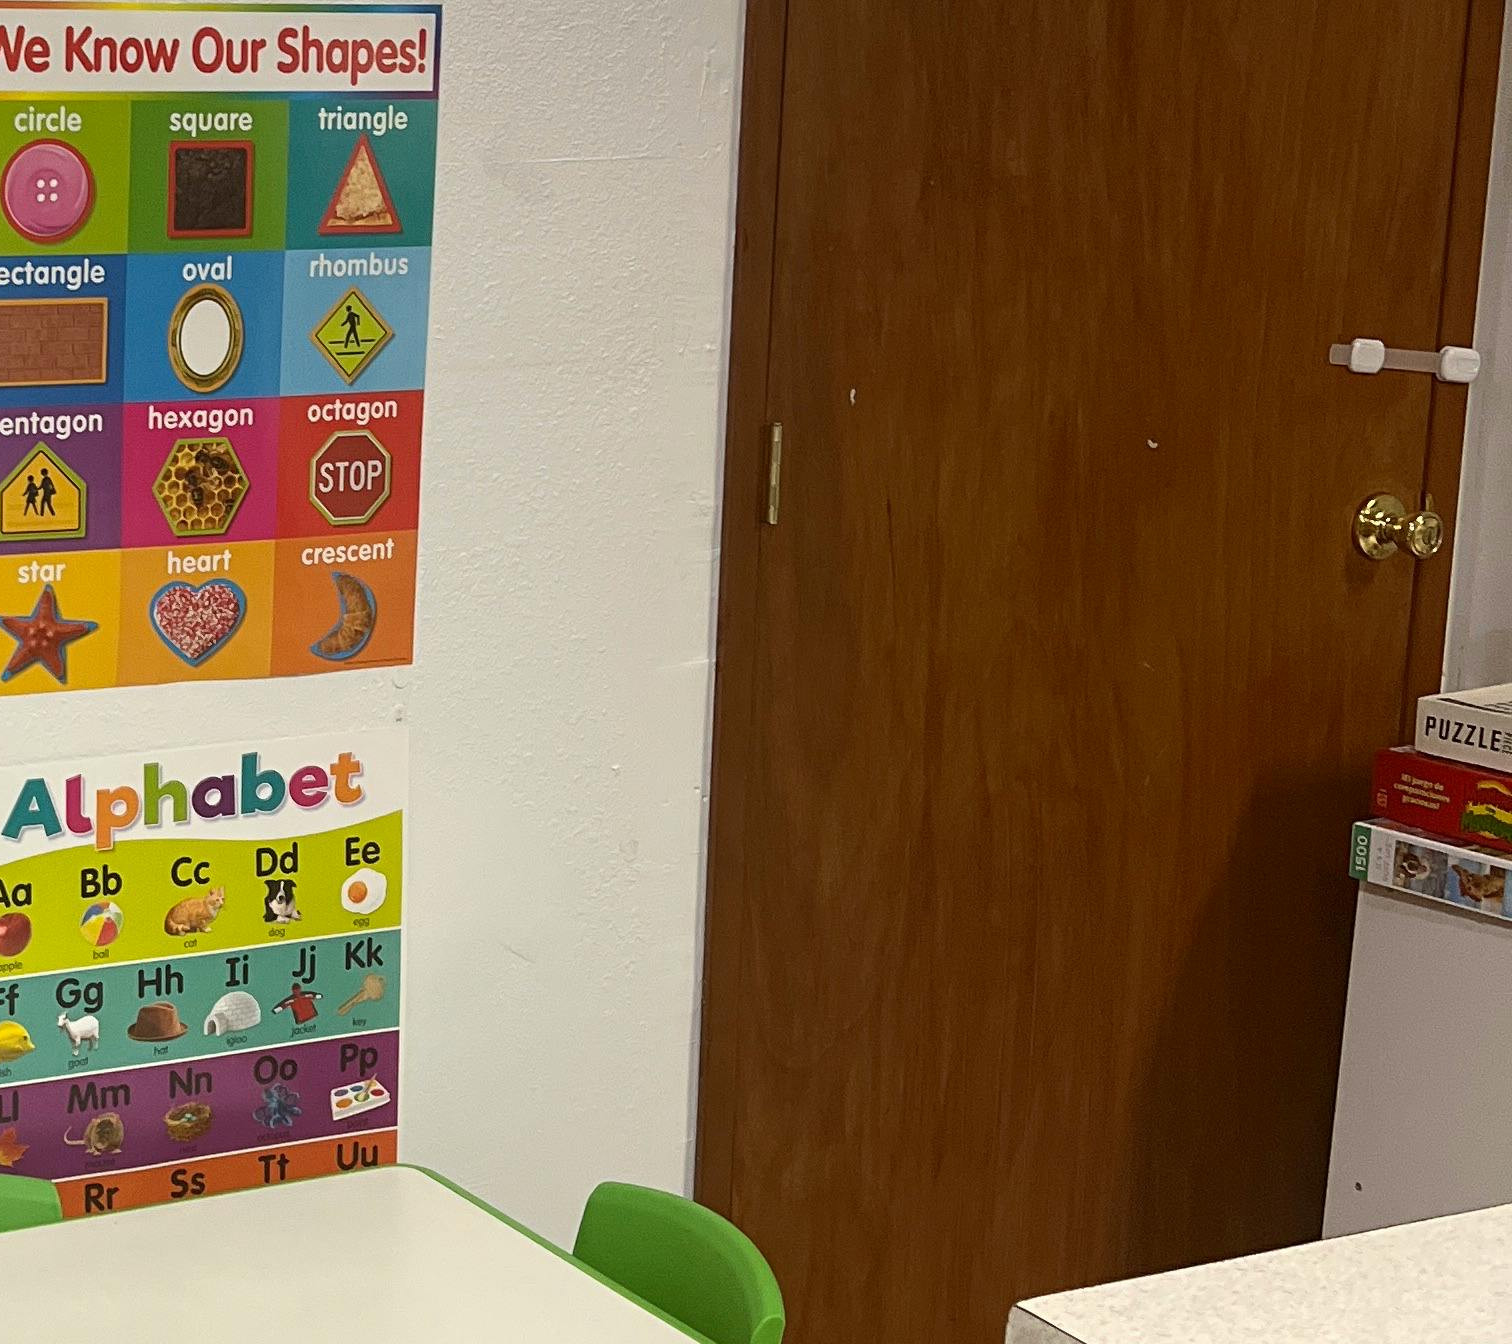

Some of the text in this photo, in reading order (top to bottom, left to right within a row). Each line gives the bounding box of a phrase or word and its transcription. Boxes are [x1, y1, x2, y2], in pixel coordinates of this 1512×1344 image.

[65, 26, 179, 73] Know
[193, 27, 266, 74] Our
[276, 24, 428, 86] Shapes!
[14, 106, 82, 133] circle
[169, 110, 254, 136] square
[318, 104, 409, 135] triangle
[182, 257, 233, 281] oval
[308, 252, 409, 278] rhombus
[147, 404, 254, 436] hexagon
[306, 397, 398, 428] octagon
[318, 459, 383, 495] STOP
[167, 550, 232, 576] heart
[300, 537, 395, 566] crescent
[17, 561, 67, 584] star
[1425, 715, 1503, 752] PUZZLE
[0, 751, 366, 851] Alphabet
[80, 864, 123, 899] Bb
[170, 856, 210, 888] Cc
[254, 841, 299, 878] Dd
[344, 836, 382, 867] Ee
[1355, 835, 1368, 871] 1500
[92, 948, 110, 960] ball
[183, 938, 198, 950] cat
[268, 927, 286, 940] dog
[353, 916, 371, 929] egg
[55, 977, 104, 1013] Gg
[137, 964, 184, 998] Hh
[225, 955, 250, 987] Ii
[292, 945, 318, 984] Jj
[344, 937, 384, 971] Kk
[68, 1057, 89, 1070] goat
[153, 1045, 169, 1057] hat
[225, 1034, 249, 1048] igloo
[289, 1024, 317, 1038] jacket
[352, 1017, 367, 1030] key
[66, 1081, 131, 1114] Mm
[168, 1068, 213, 1098] Nn
[253, 1055, 298, 1085] Oo
[339, 1044, 379, 1076] Pp
[84, 1141, 379, 1213] Rr Ss Tt Uu
